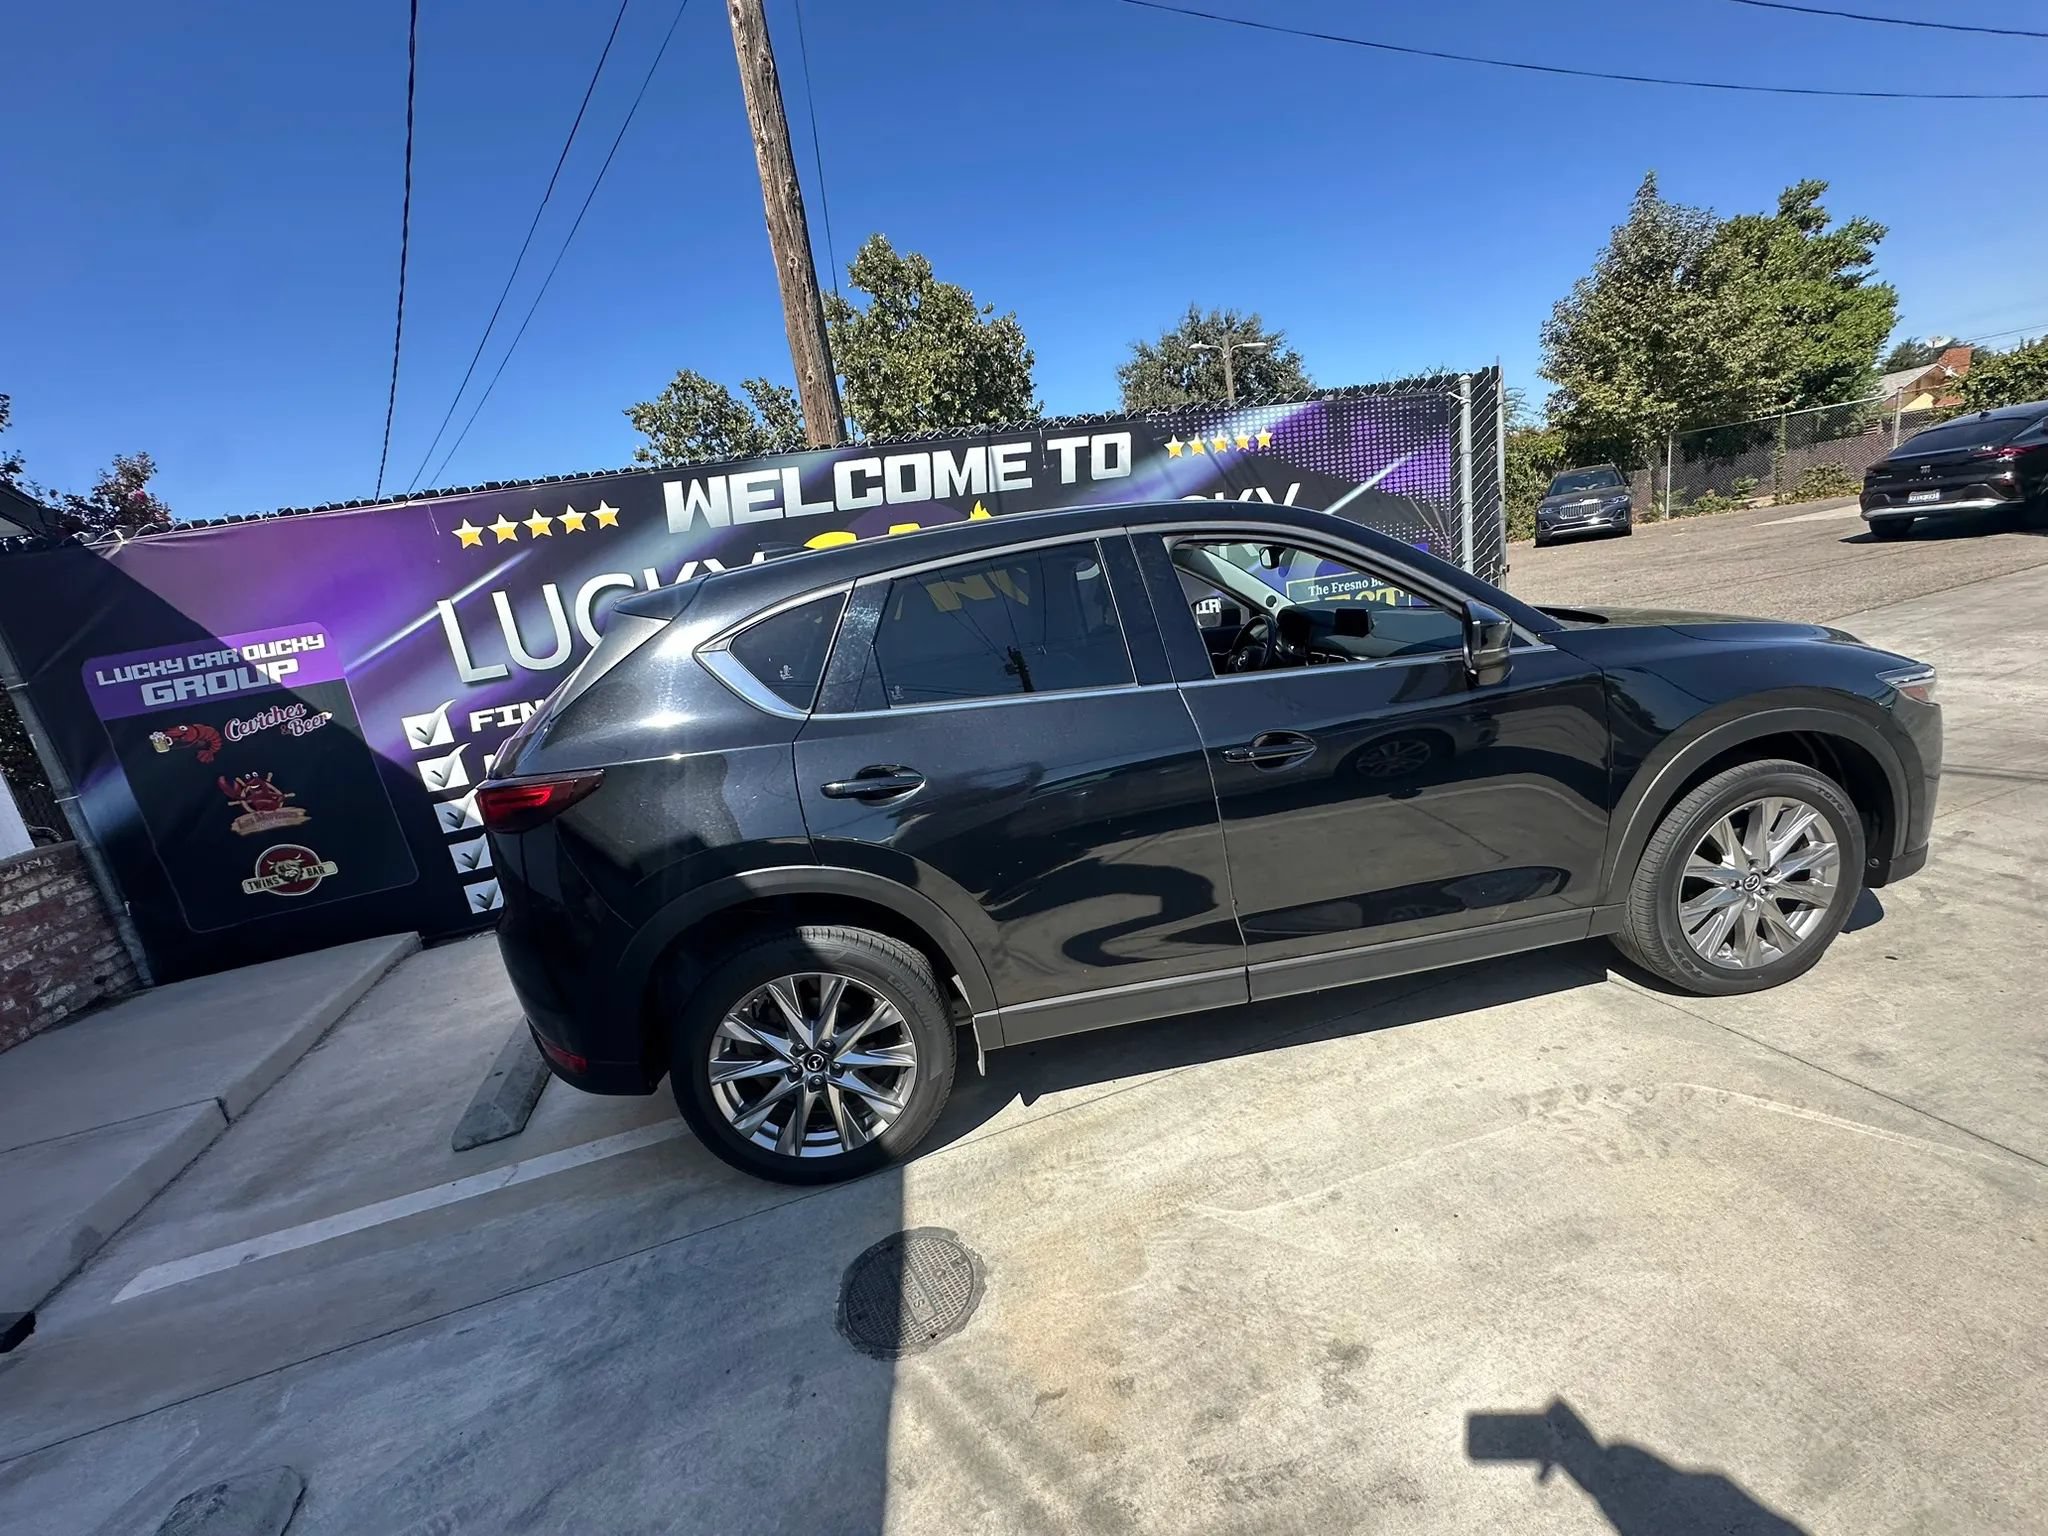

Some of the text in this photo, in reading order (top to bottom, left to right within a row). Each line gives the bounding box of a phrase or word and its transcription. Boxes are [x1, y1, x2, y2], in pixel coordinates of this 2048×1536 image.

[663, 441, 1033, 535] WELCOME
[1046, 431, 1131, 484] TO
[1308, 583, 1330, 597] The
[1331, 580, 1369, 594] Fresno
[436, 551, 765, 684] LUC
[95, 657, 185, 686] LUCKY
[187, 648, 240, 671] CAR
[141, 658, 299, 706] GROUP
[224, 703, 307, 742] Ceviches
[288, 711, 333, 737] Beer
[247, 866, 326, 891] TWINS BAR
